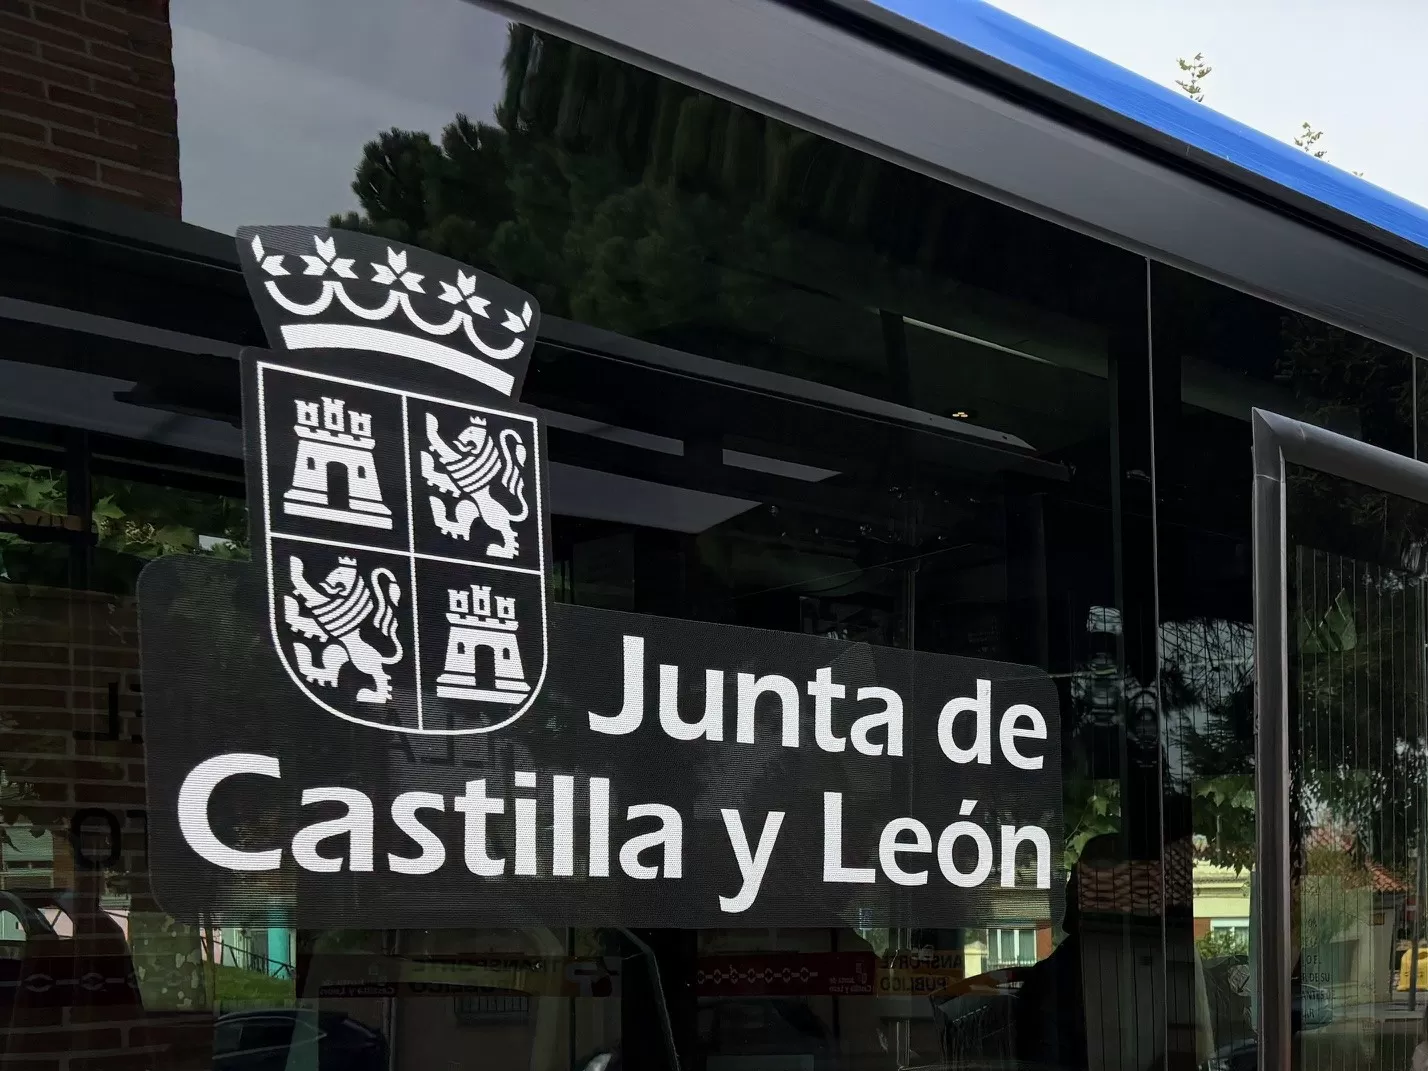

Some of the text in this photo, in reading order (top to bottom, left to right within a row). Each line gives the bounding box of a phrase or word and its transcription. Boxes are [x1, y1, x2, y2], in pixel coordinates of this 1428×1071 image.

[588, 635, 904, 759] Junta
[937, 679, 1048, 770] de
[178, 752, 683, 880] Castilla
[718, 808, 786, 913] y
[822, 791, 1051, 889] León
